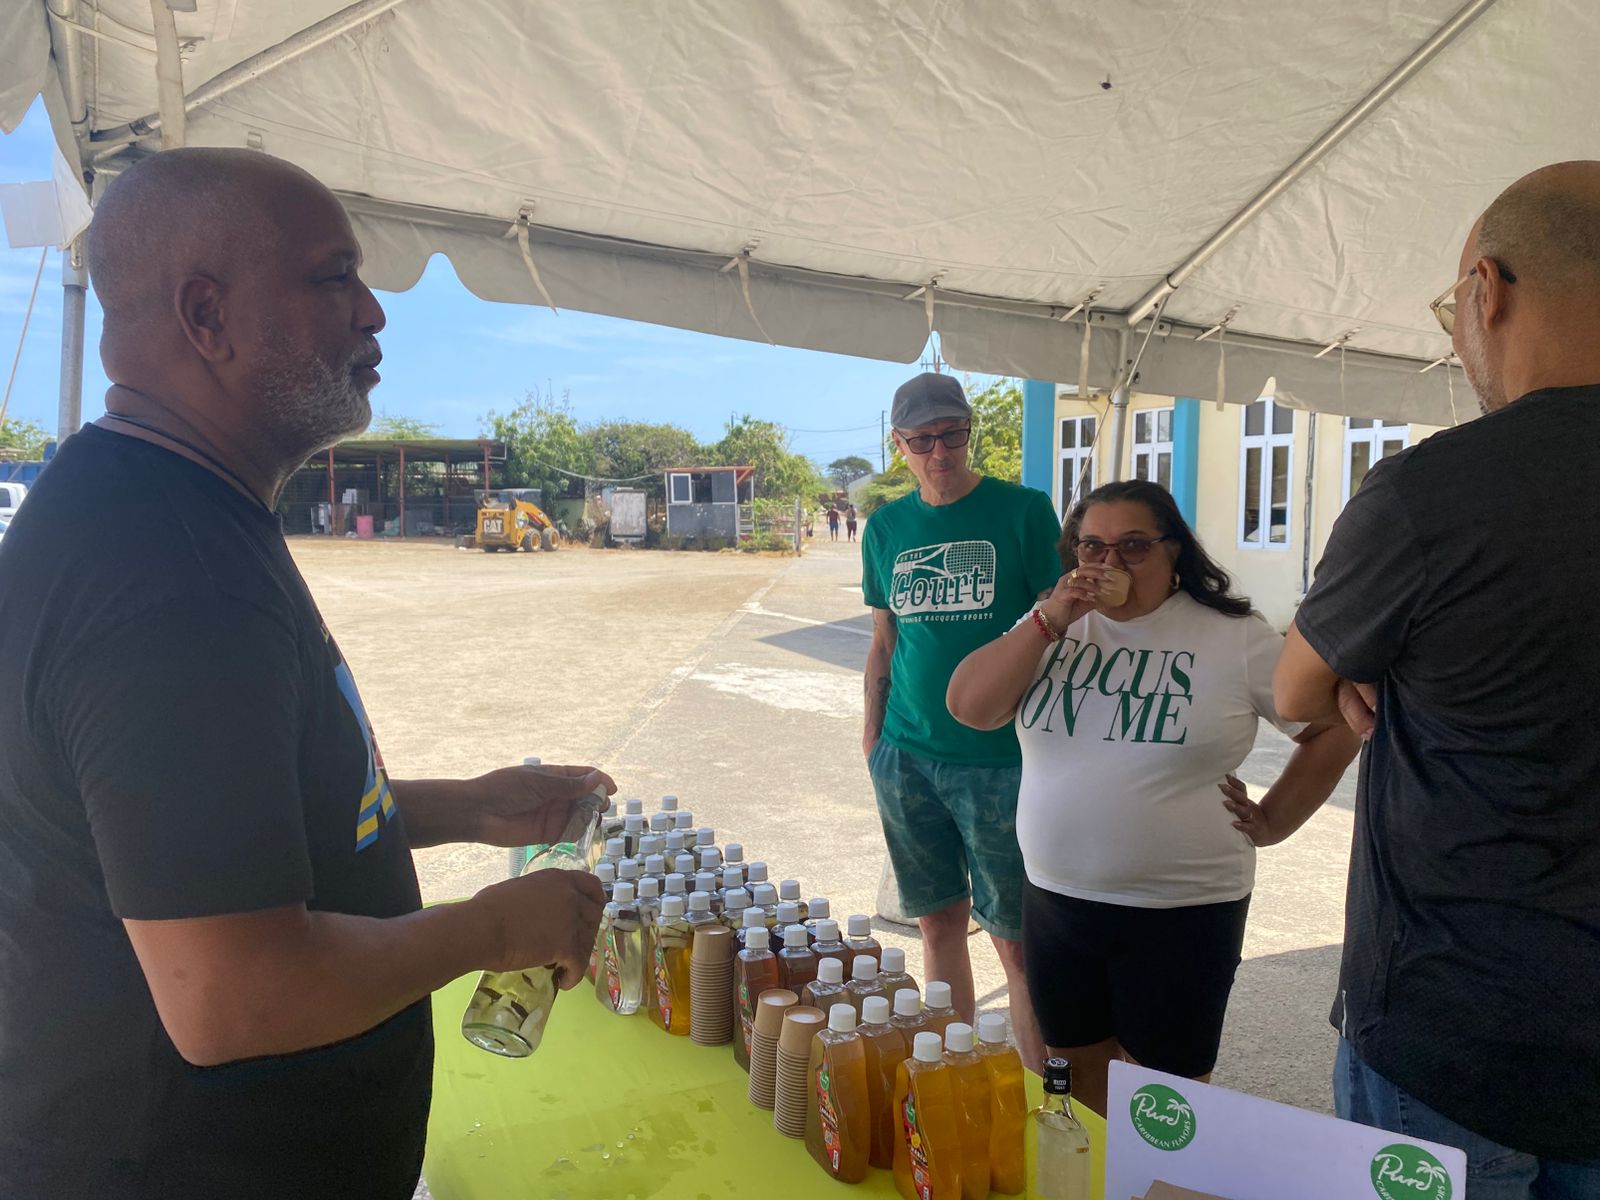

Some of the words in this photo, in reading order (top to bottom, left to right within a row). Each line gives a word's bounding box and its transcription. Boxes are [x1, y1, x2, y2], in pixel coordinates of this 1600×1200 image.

[483, 519, 503, 534] CAT
[892, 566, 987, 610] Court
[924, 614, 960, 623] RACQUET
[963, 612, 993, 622] SPORTS
[1038, 637, 1196, 700] FOCUS
[1020, 676, 1094, 737] ON
[1102, 690, 1193, 745] ME
[1133, 1092, 1181, 1126] Pure
[1134, 1116, 1170, 1148] CARIBBEAN
[1171, 1119, 1191, 1148] FLAVORS
[1374, 1153, 1434, 1191] Pure
